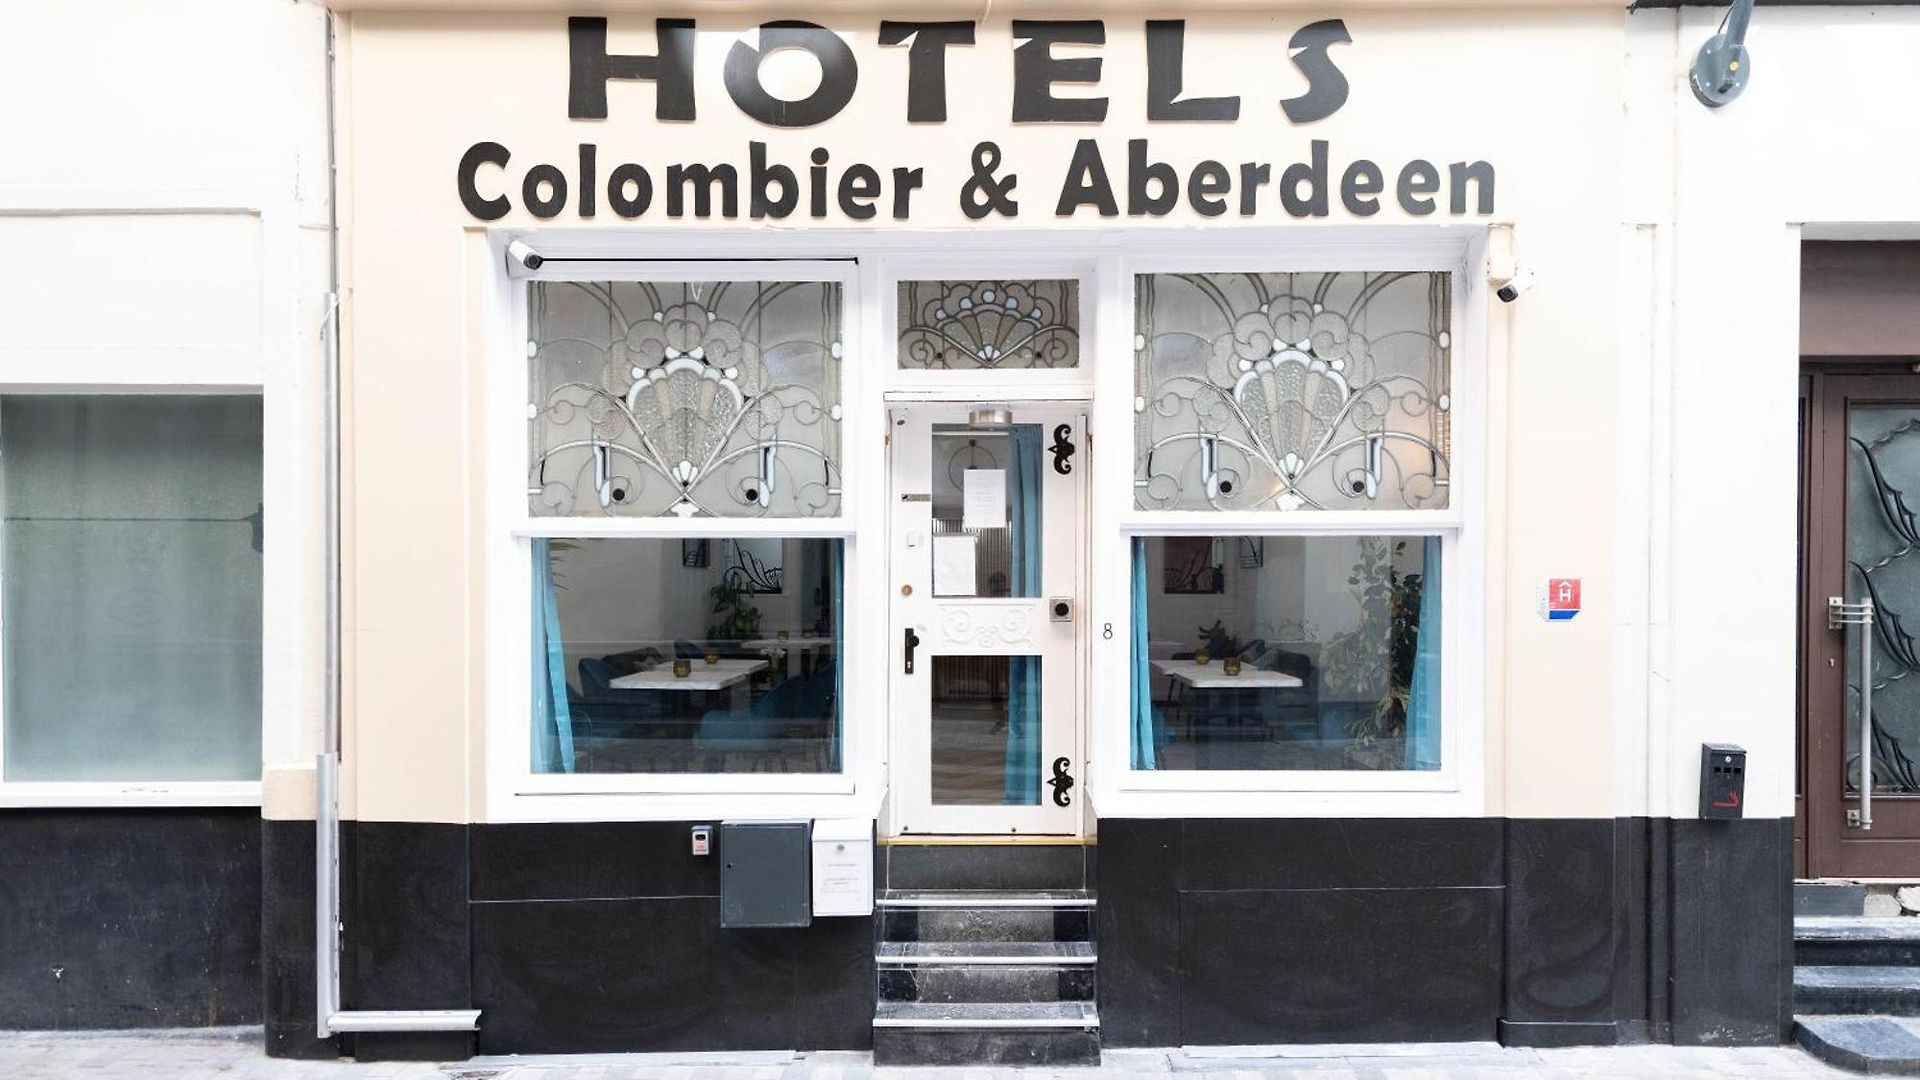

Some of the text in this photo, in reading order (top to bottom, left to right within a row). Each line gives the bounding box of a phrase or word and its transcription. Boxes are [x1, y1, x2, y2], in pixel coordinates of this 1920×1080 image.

[567, 16, 1353, 127] HOTELS
[457, 138, 1496, 221] Colombier & Aberdeen
[1103, 622, 1113, 640] 8
